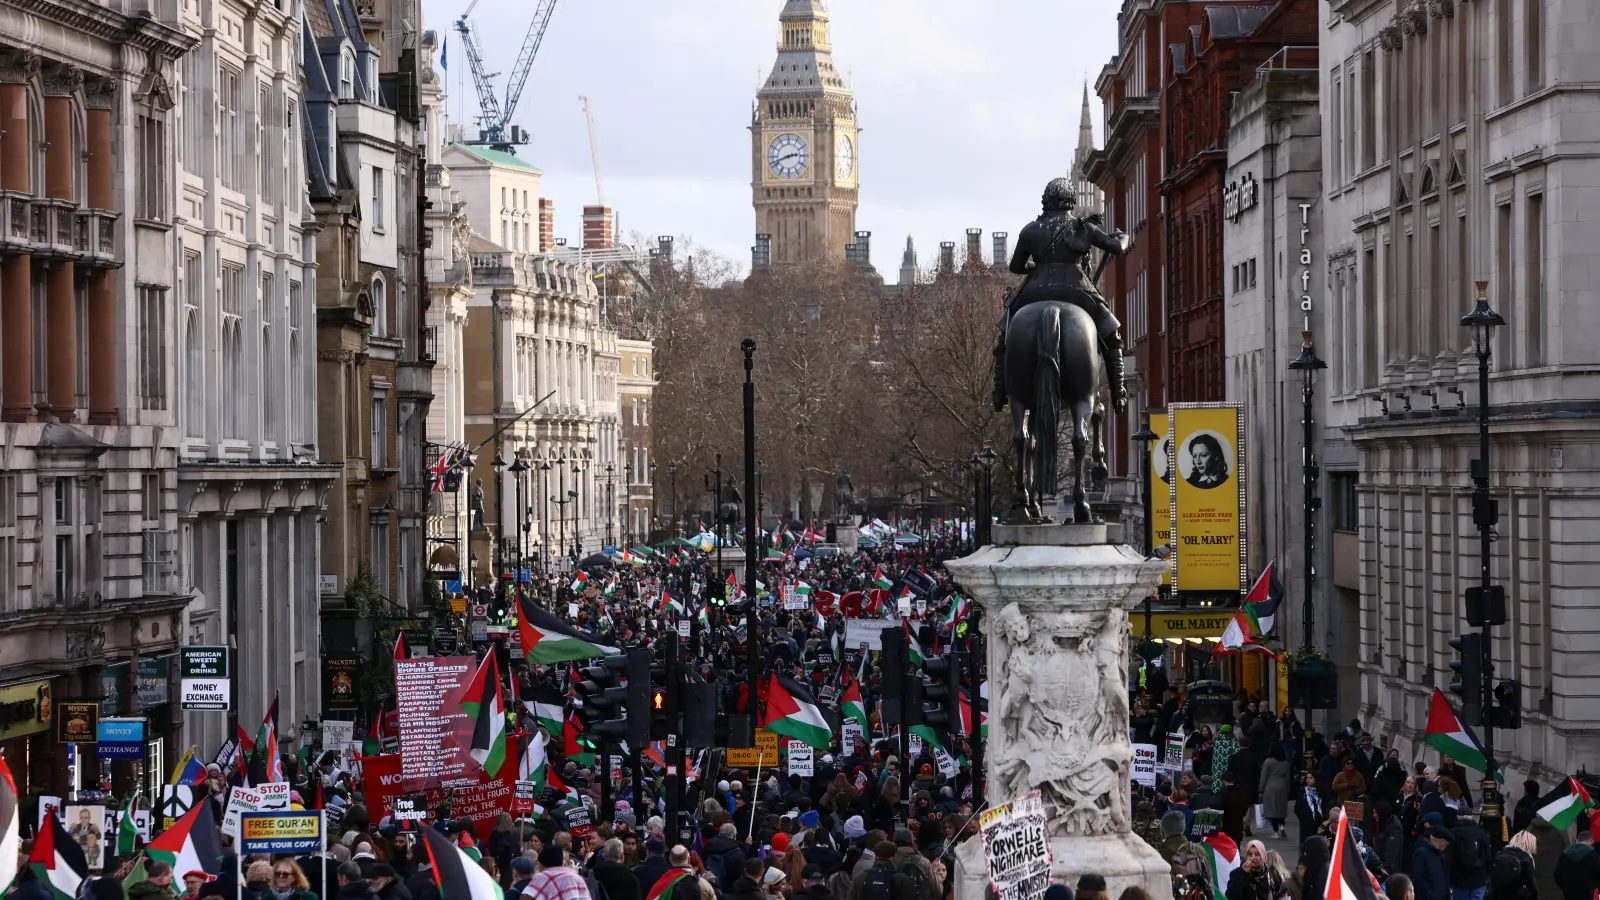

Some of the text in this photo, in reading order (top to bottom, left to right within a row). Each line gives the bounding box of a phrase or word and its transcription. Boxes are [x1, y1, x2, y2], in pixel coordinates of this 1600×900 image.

[1156, 530, 1170, 539] "OH
[1201, 535, 1235, 545] MARY!"
[1164, 618, 1229, 630] "OH, MARY!"
[401, 731, 454, 740] ESTABLISHMENT
[1136, 749, 1155, 759] Stop
[1166, 749, 1182, 759] FREE
[1134, 759, 1155, 767] Arming
[260, 785, 287, 795] STOP
[478, 778, 505, 792] WHERE
[234, 790, 261, 804] STOP
[453, 797, 466, 805] THE
[468, 793, 486, 804] FULL
[487, 787, 510, 799] FRUITS
[231, 799, 258, 812] ARMING
[397, 799, 414, 809] Free
[463, 805, 477, 814] ON
[482, 800, 496, 810] THE
[569, 811, 589, 819] FREEDOM
[248, 819, 314, 829] FREE QUR'AN
[570, 820, 592, 828] PALESTINE
[247, 842, 269, 850] TAKE
[271, 841, 293, 849] YOUR
[990, 841, 1045, 878] NIGHTMARE
[1018, 869, 1050, 900] MINISTRY
